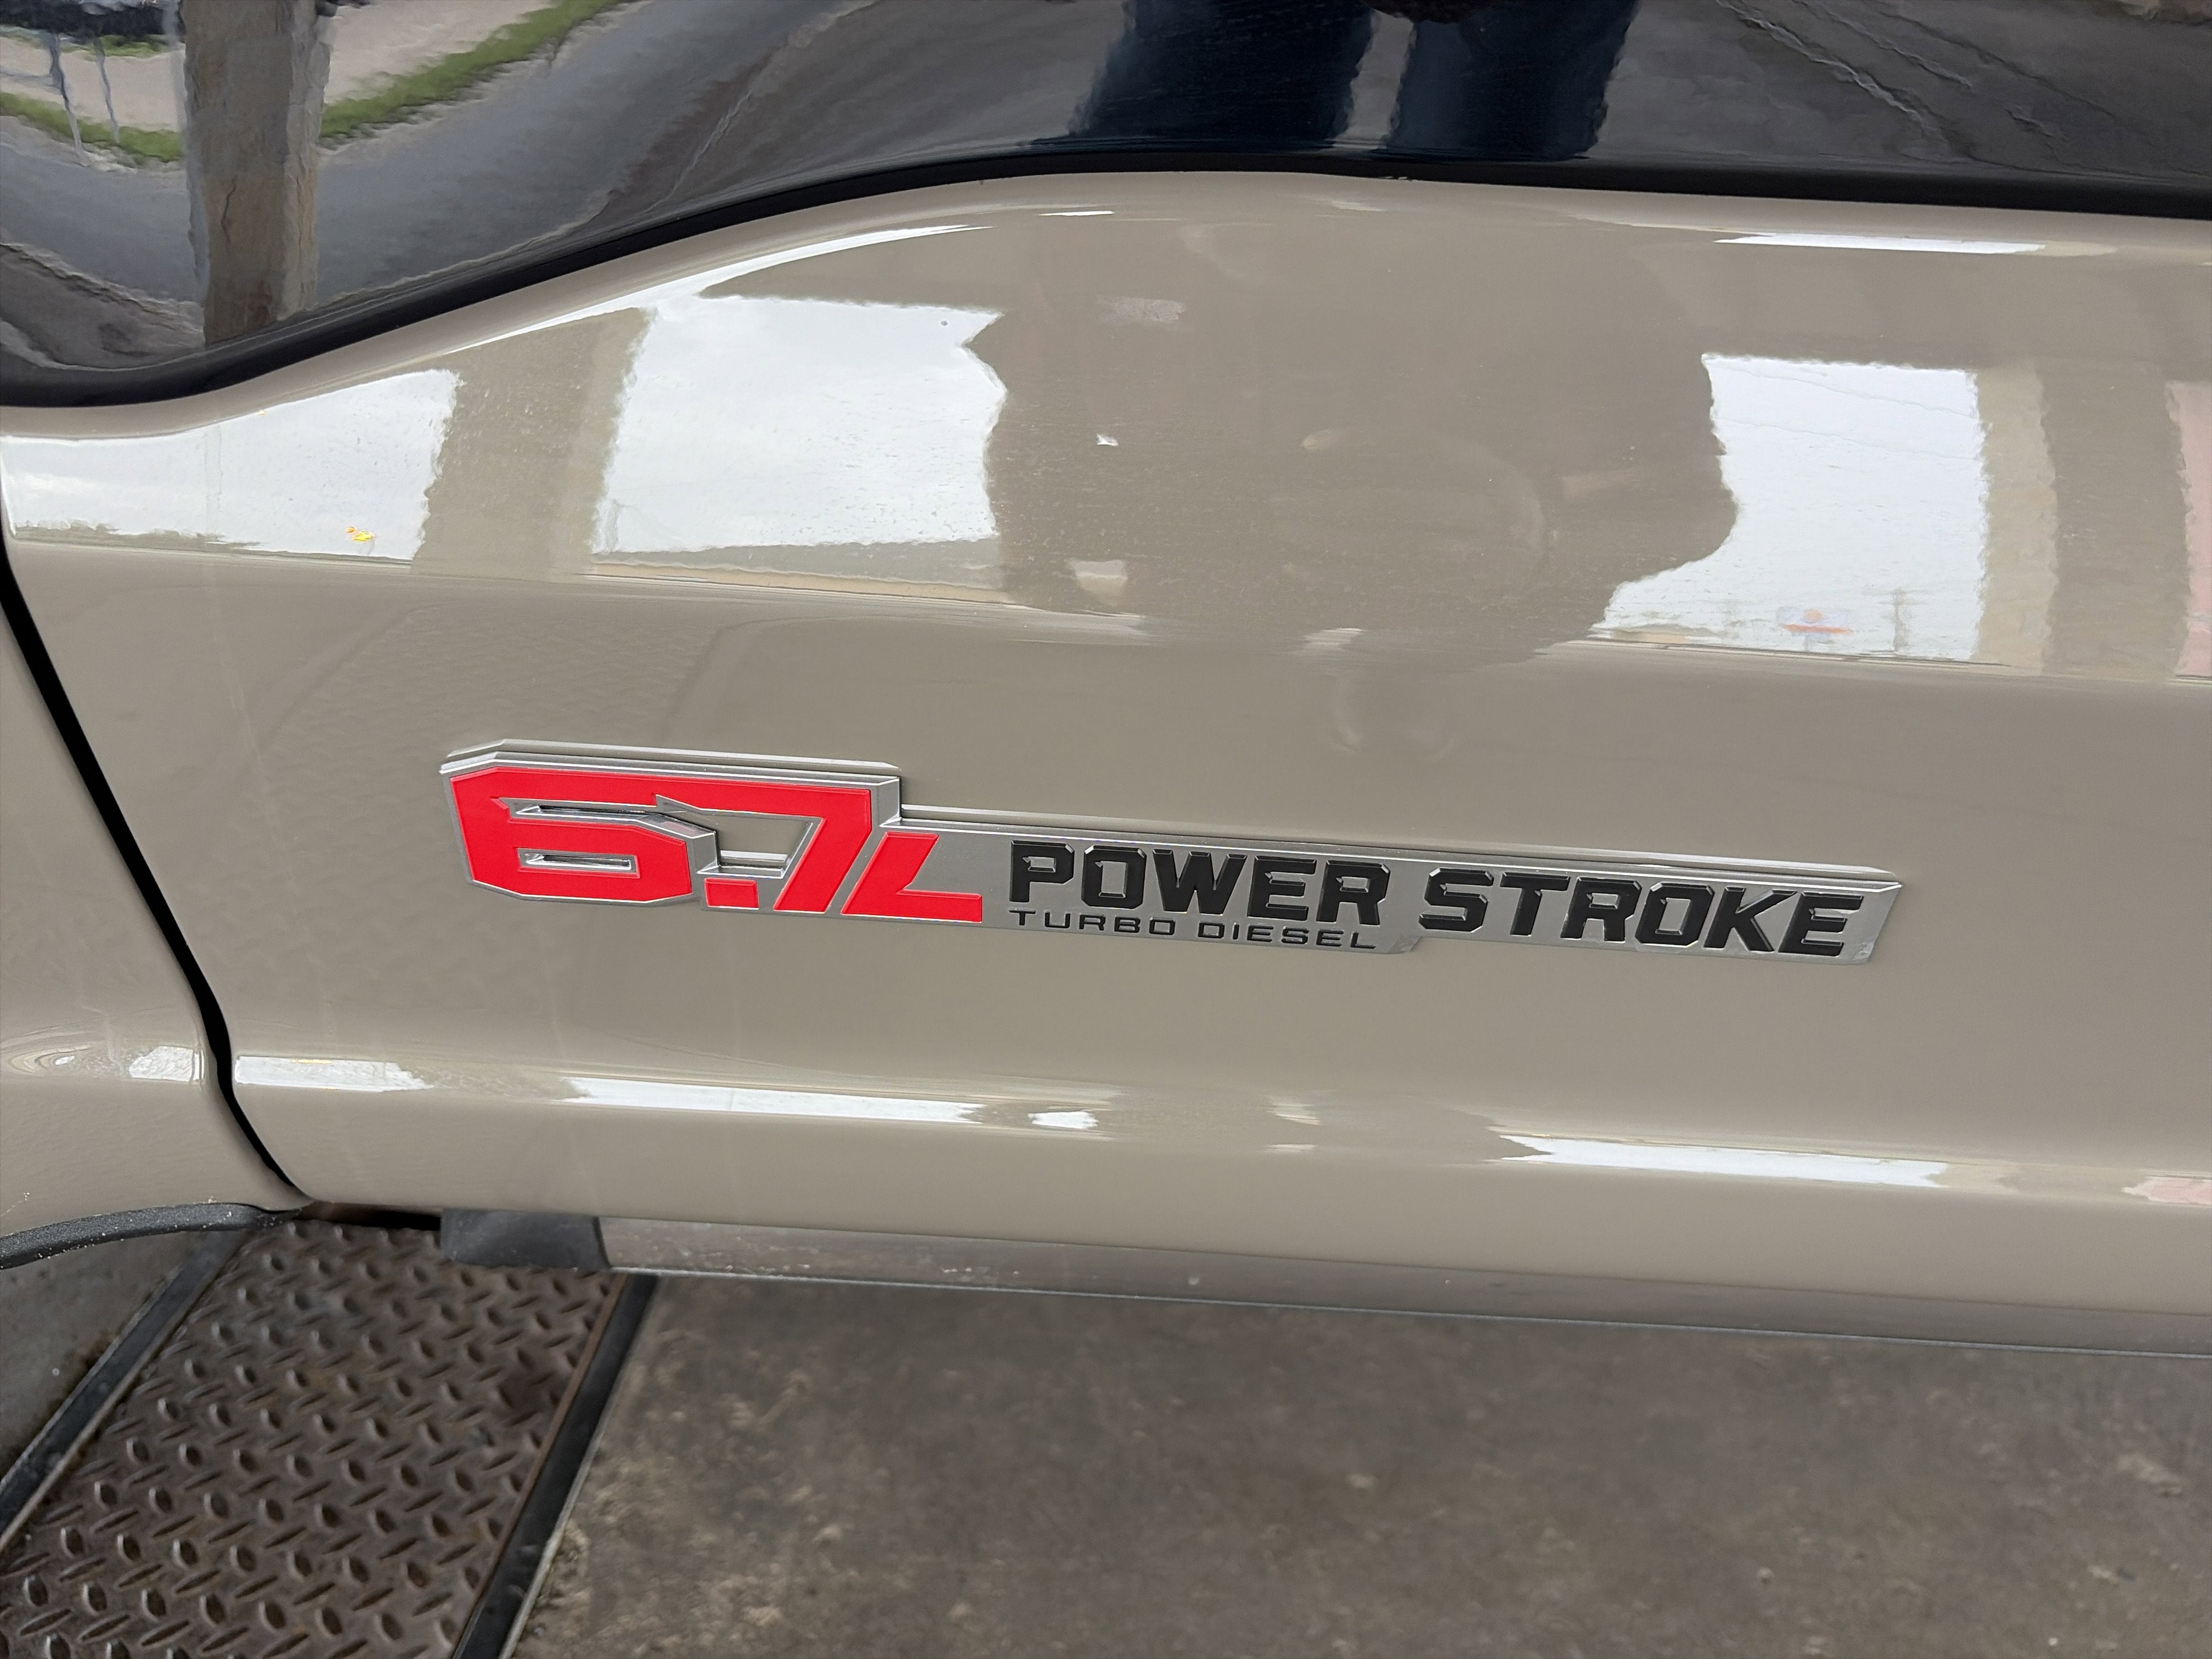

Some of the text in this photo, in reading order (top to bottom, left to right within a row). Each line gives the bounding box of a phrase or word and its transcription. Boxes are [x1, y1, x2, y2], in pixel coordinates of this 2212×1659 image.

[450, 766, 1864, 956] 6.7L POWER STROKE
[1009, 910, 1376, 950] TURBO DIESEL
